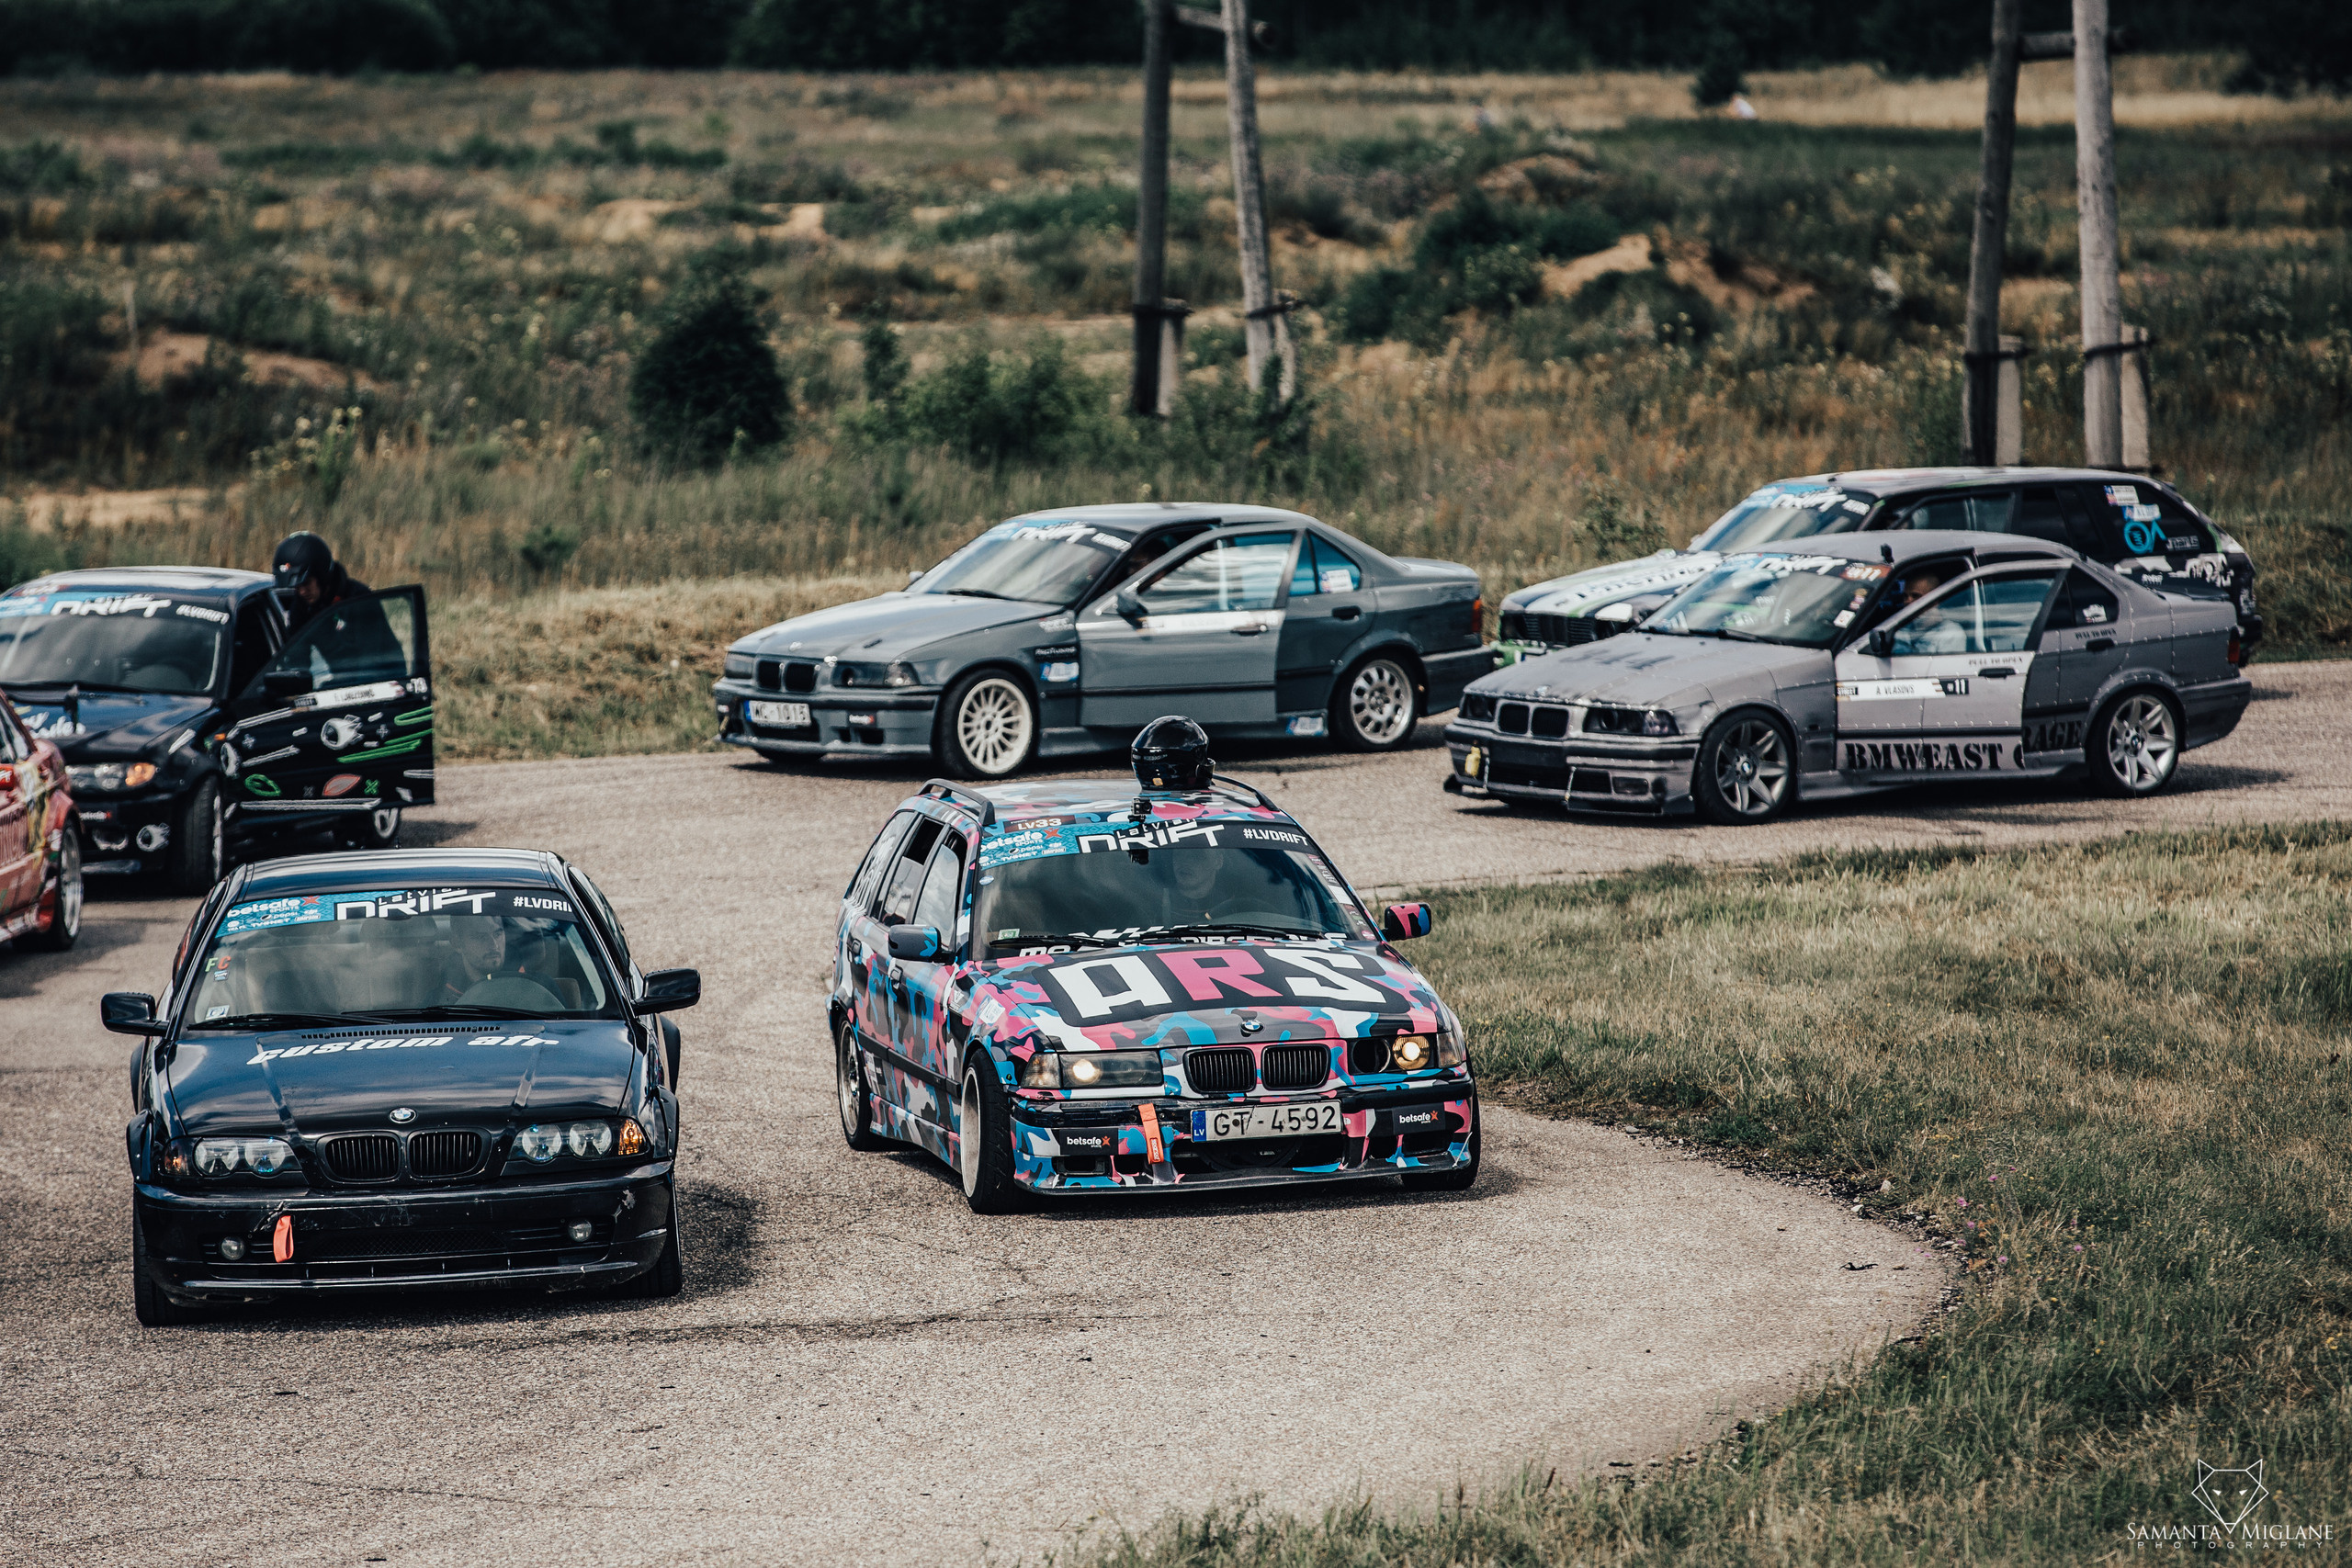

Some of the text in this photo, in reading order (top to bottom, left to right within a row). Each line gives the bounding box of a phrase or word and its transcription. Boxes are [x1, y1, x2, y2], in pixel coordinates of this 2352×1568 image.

[1845, 742, 2003, 771] BMWEAST
[1017, 818, 1062, 830] LV33
[1079, 821, 1225, 853] DRIFT
[1243, 828, 1309, 846] #LVDRIFT
[227, 898, 300, 918] betsafe
[336, 889, 496, 920] DRIFT
[246, 1036, 454, 1065] custom
[1399, 1112, 1430, 1124] betsafe
[1067, 1136, 1102, 1145] betsafe
[1193, 1129, 1205, 1137] LV
